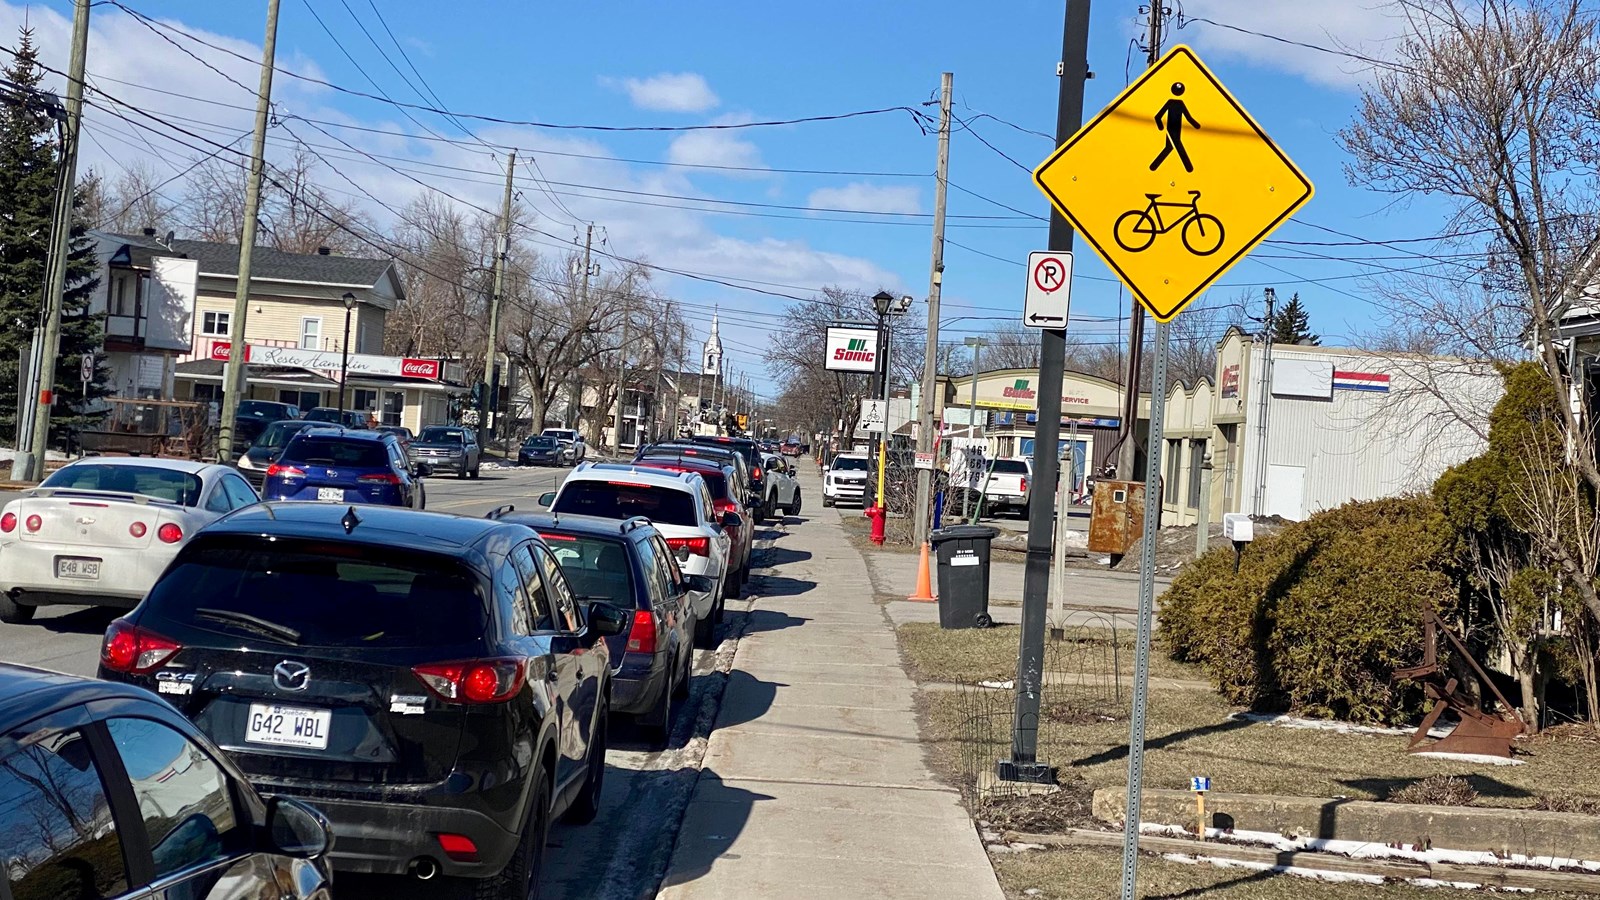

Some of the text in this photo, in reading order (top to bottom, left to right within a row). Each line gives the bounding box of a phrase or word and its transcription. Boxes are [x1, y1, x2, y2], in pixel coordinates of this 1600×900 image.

[1044, 265, 1057, 284] P
[265, 348, 369, 371] Resto Hamlin
[833, 347, 875, 362] Sonic
[1002, 386, 1036, 400] Sonic
[60, 561, 77, 573] E48
[155, 671, 198, 683] CX-5
[251, 712, 324, 739] G42 WBL
